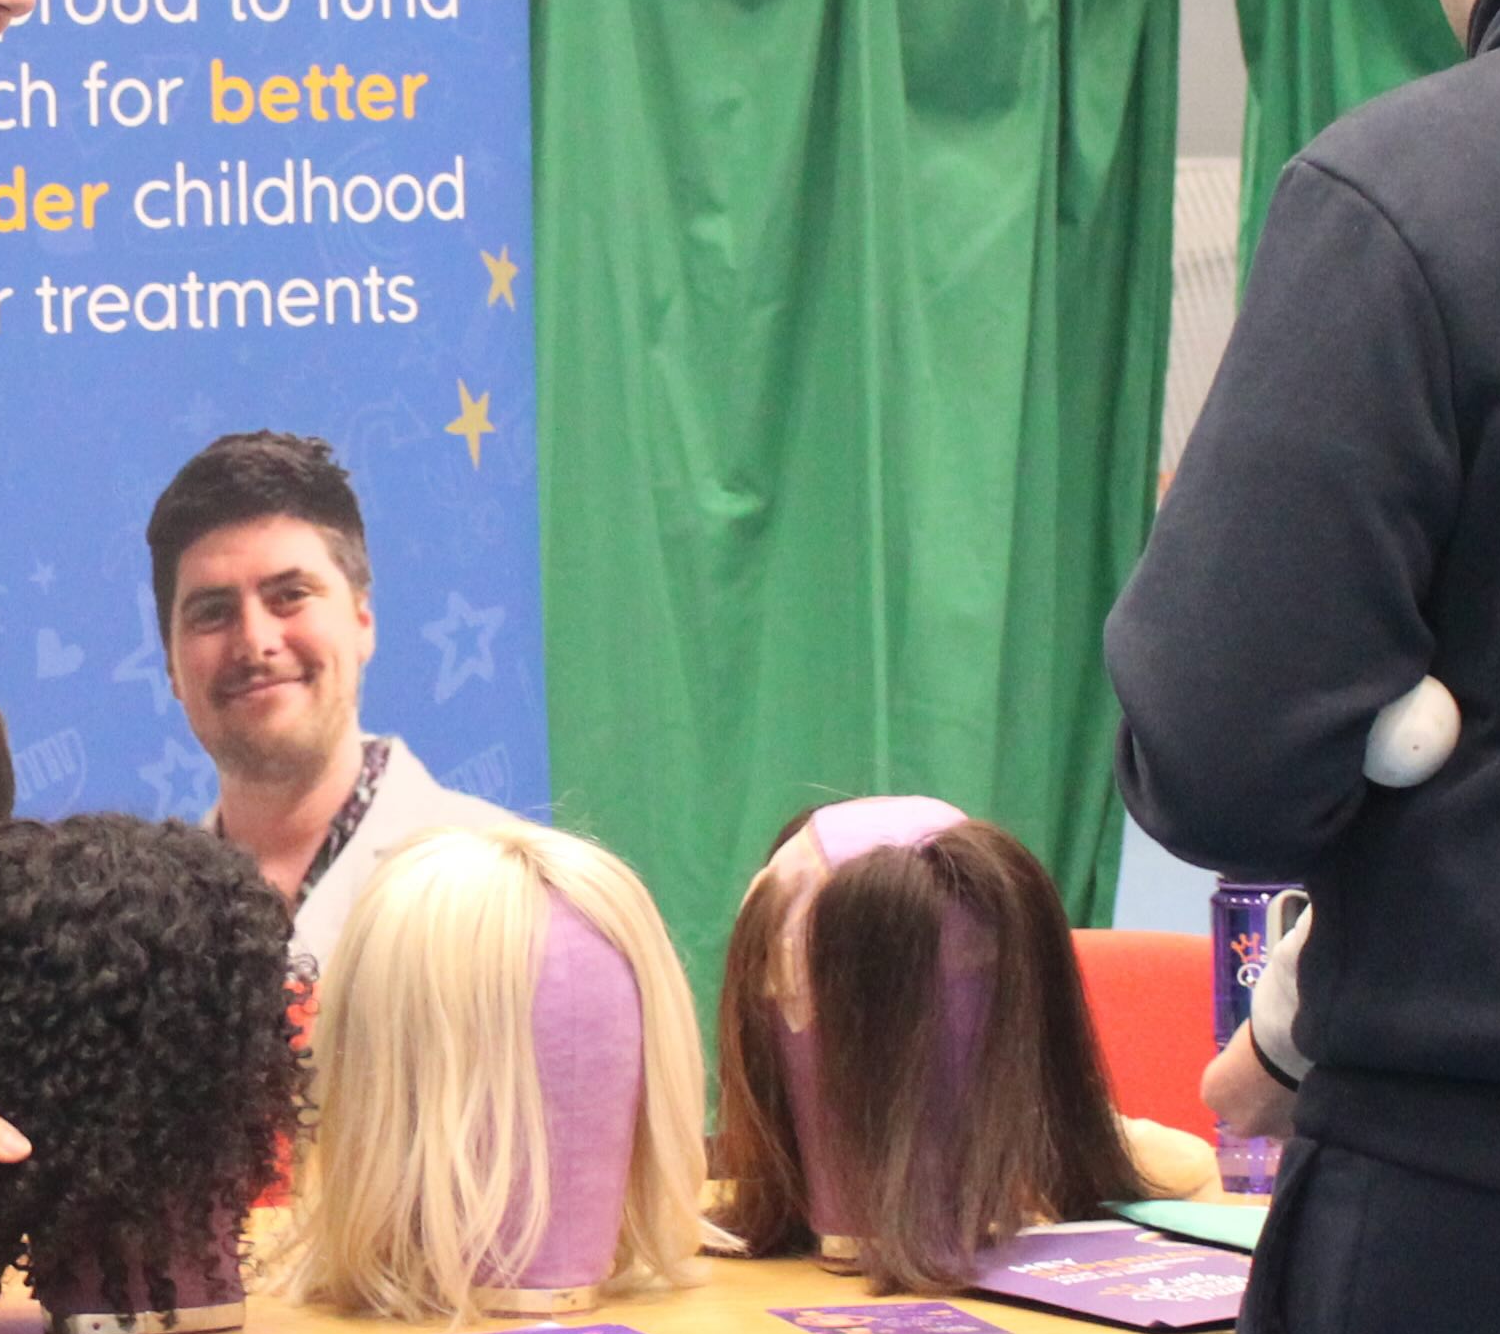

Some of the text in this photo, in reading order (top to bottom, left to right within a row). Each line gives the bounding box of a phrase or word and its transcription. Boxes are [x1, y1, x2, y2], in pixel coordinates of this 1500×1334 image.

[81, 60, 185, 128] for
[210, 58, 429, 124] better
[132, 155, 467, 229] childhood
[35, 266, 421, 337] treatments
